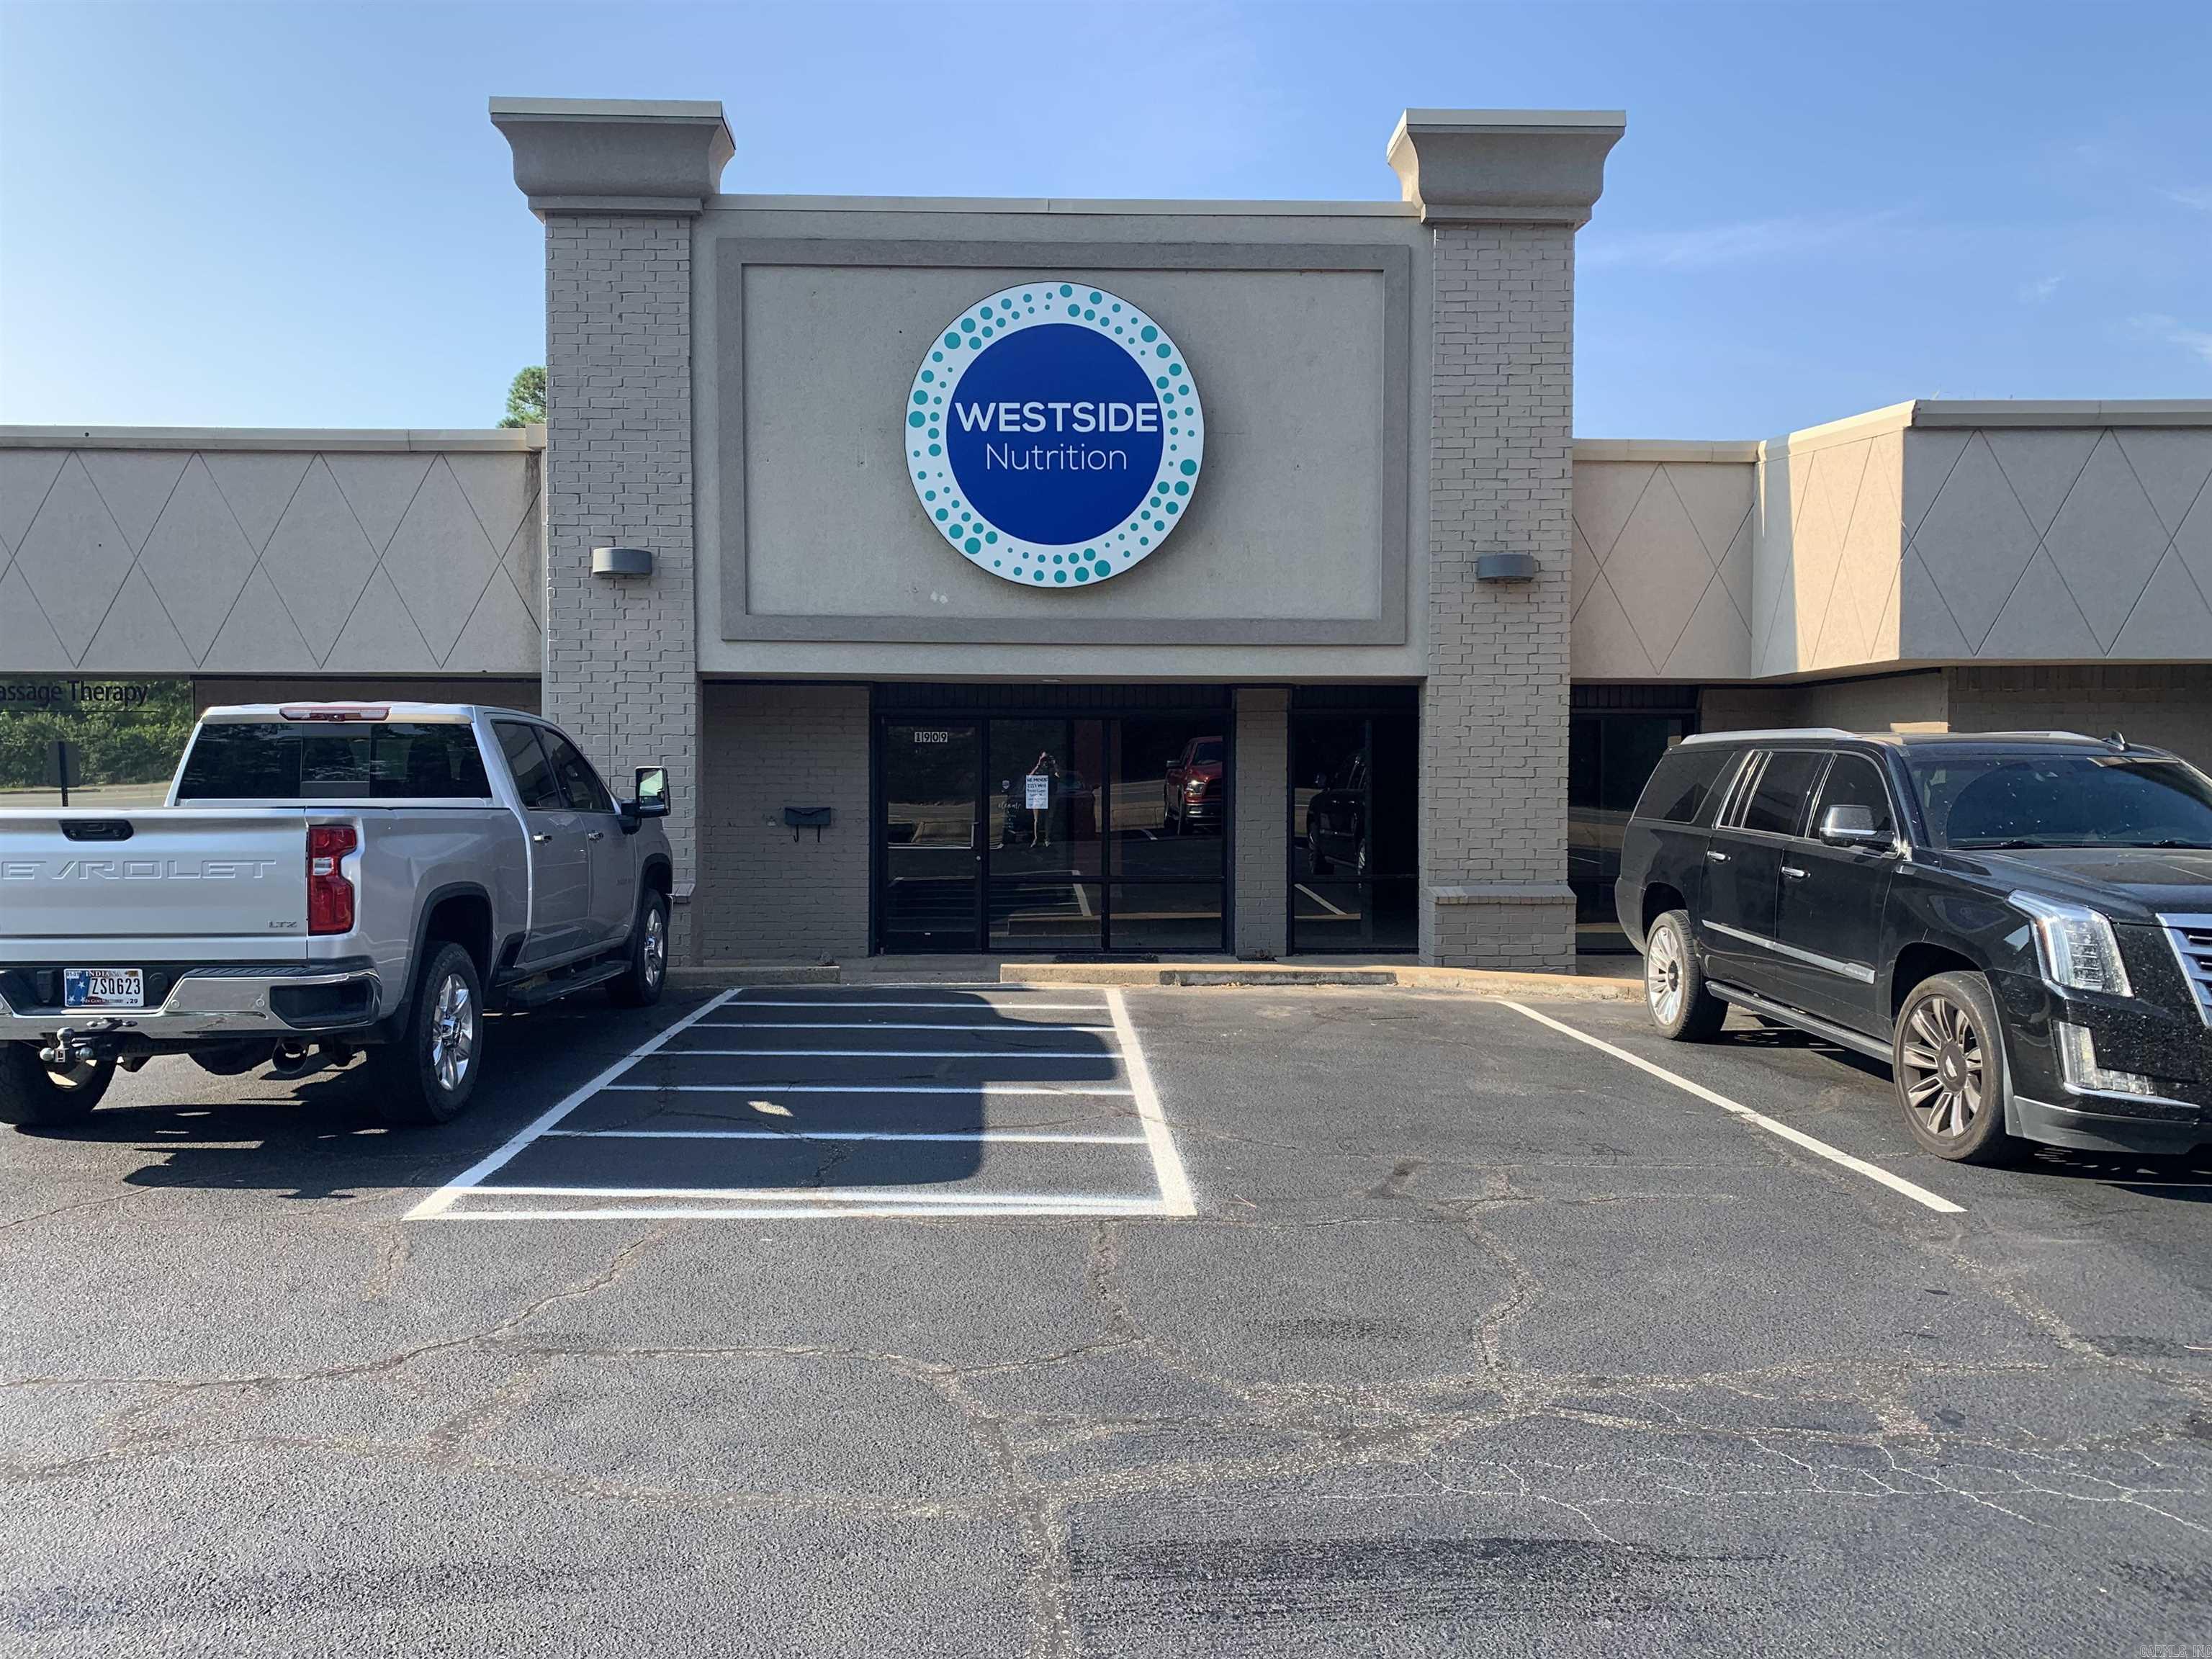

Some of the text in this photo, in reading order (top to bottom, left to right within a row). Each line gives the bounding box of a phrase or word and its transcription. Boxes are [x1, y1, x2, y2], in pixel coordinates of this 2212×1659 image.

[955, 401, 1159, 433] WESTSIDE
[986, 443, 1128, 471] Nutrition
[67, 680, 148, 707] Therapy
[915, 732, 947, 742] 1909
[91, 978, 140, 994] ZSQ623
